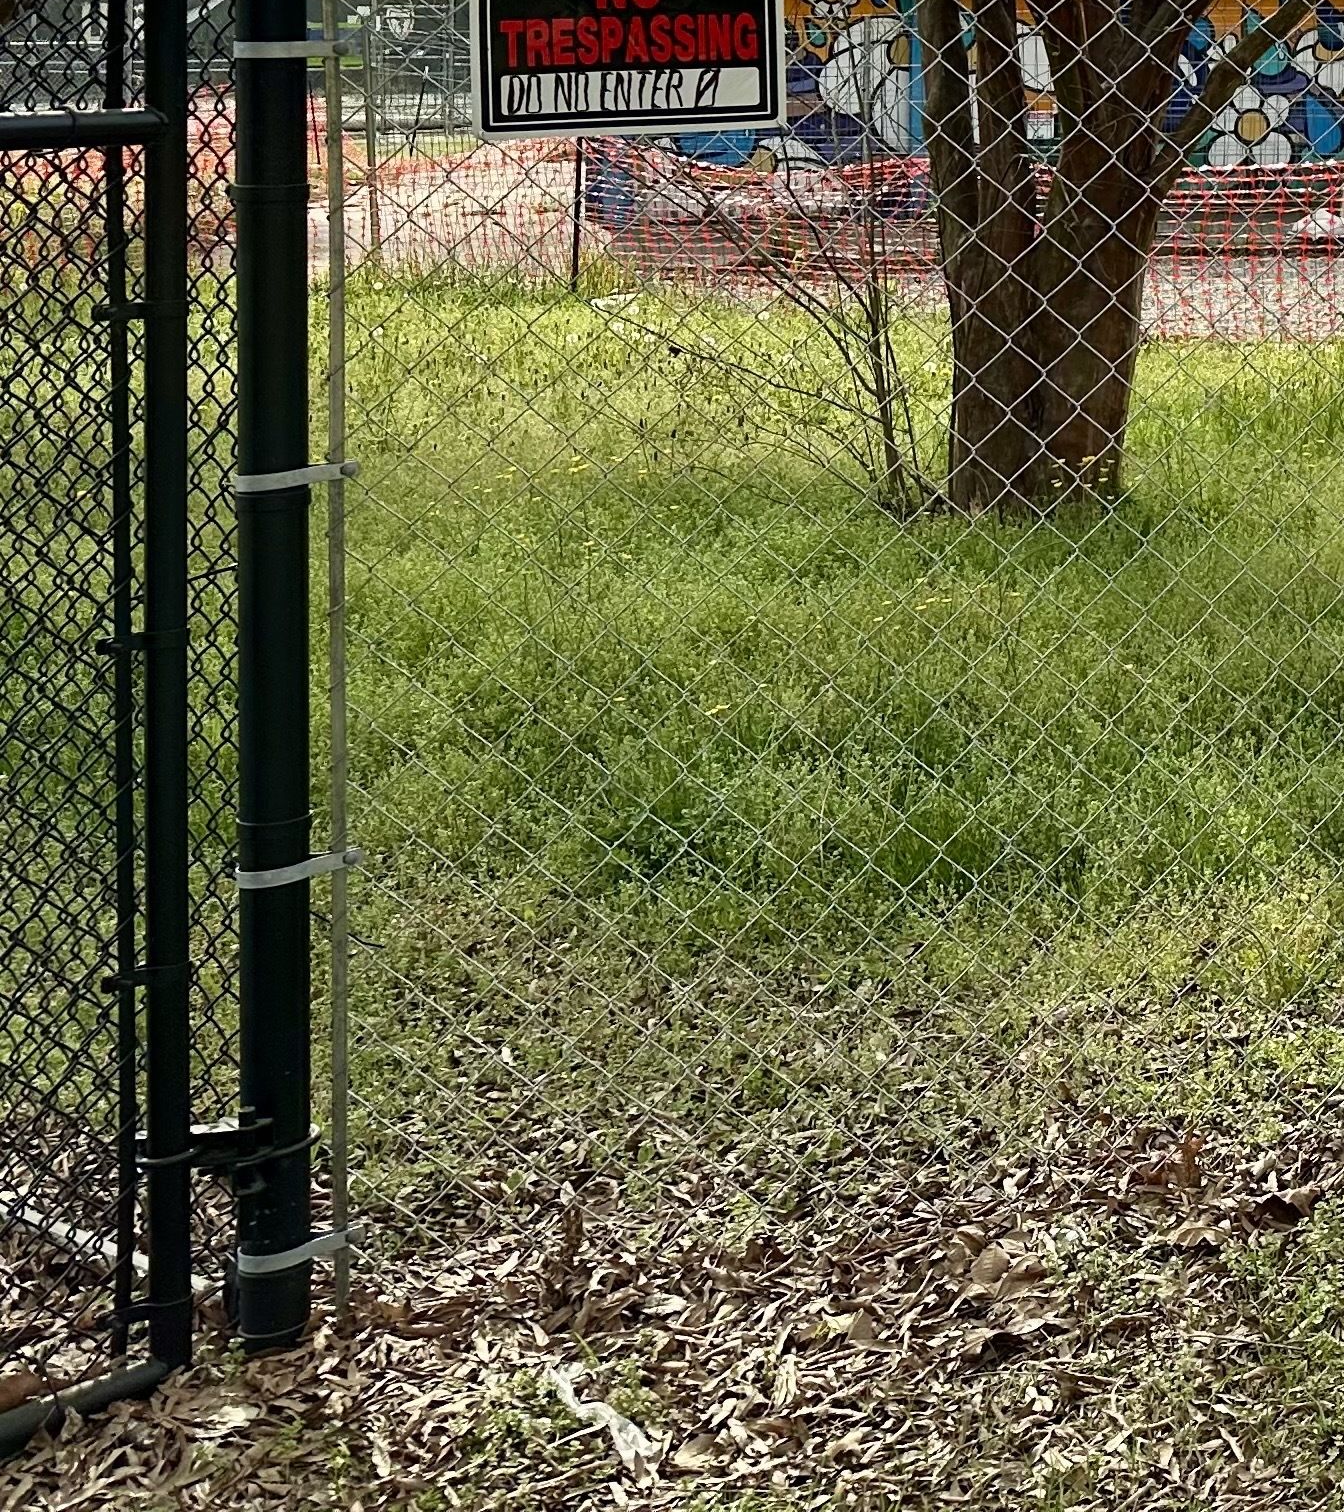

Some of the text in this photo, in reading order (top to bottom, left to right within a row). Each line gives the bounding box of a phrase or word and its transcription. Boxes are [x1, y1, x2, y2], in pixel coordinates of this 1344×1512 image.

[500, 12, 759, 68] TRESPASSING
[507, 74, 542, 115] DO
[554, 72, 590, 113] NO
[600, 68, 683, 111] ENTER
